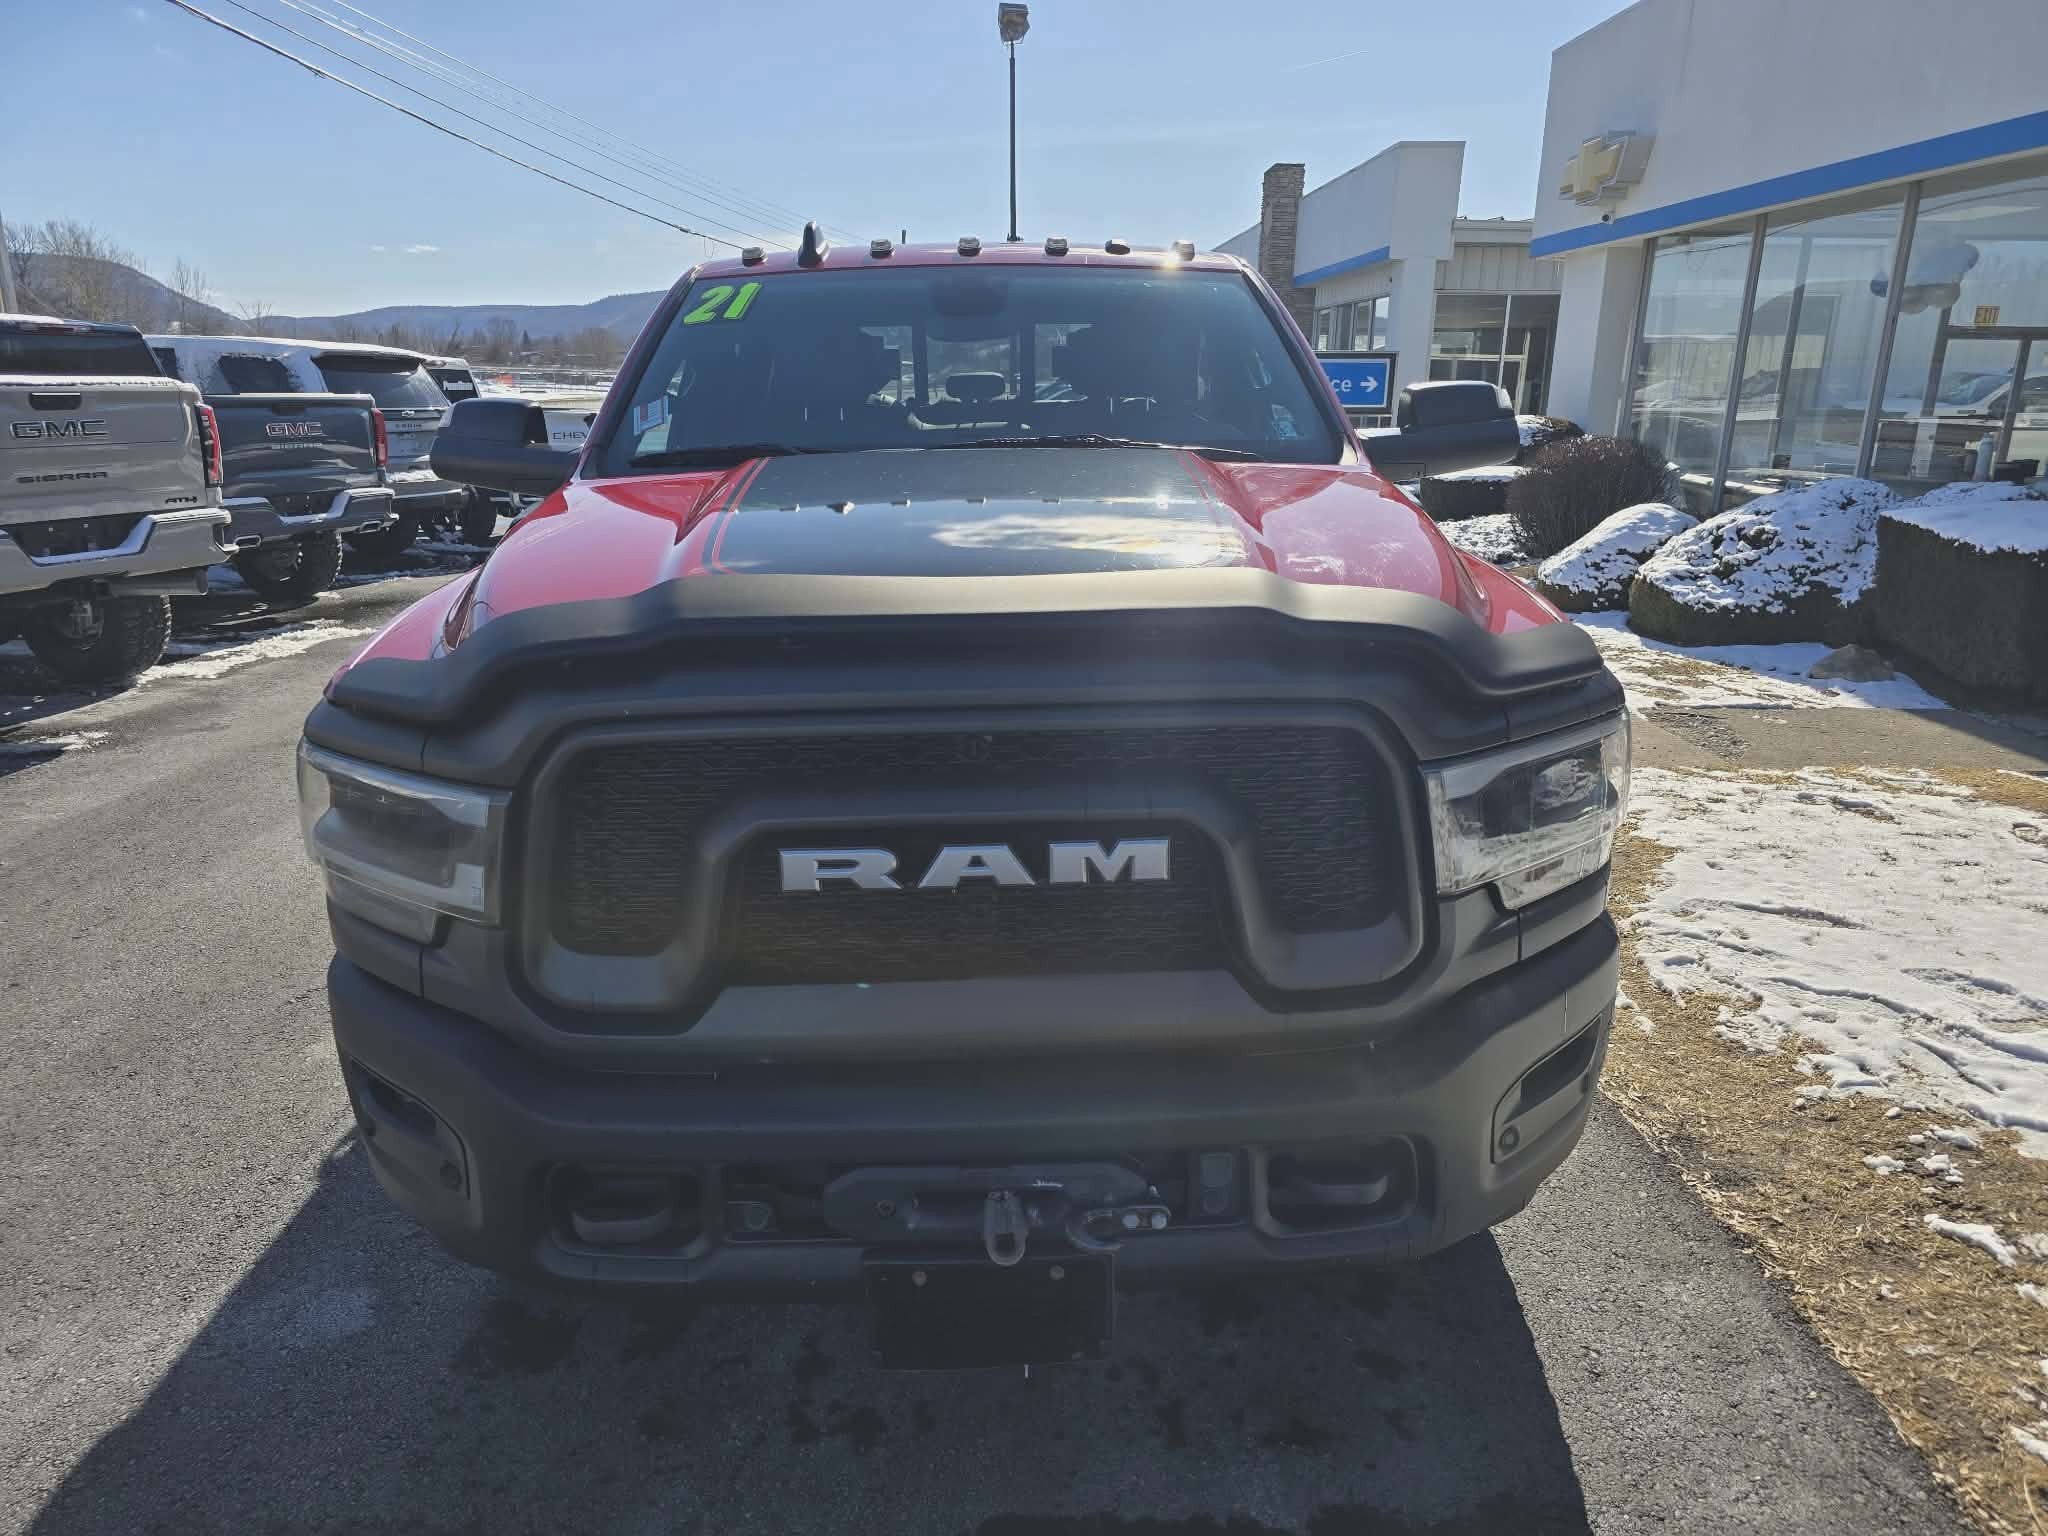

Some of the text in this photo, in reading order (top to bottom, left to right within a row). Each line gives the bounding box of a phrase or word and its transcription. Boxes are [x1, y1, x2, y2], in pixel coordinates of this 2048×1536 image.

[683, 282, 762, 325] 21
[9, 419, 109, 440] GMC
[265, 421, 324, 437] GMC
[17, 471, 108, 484] SIERRA
[778, 838, 1171, 892] RAM
